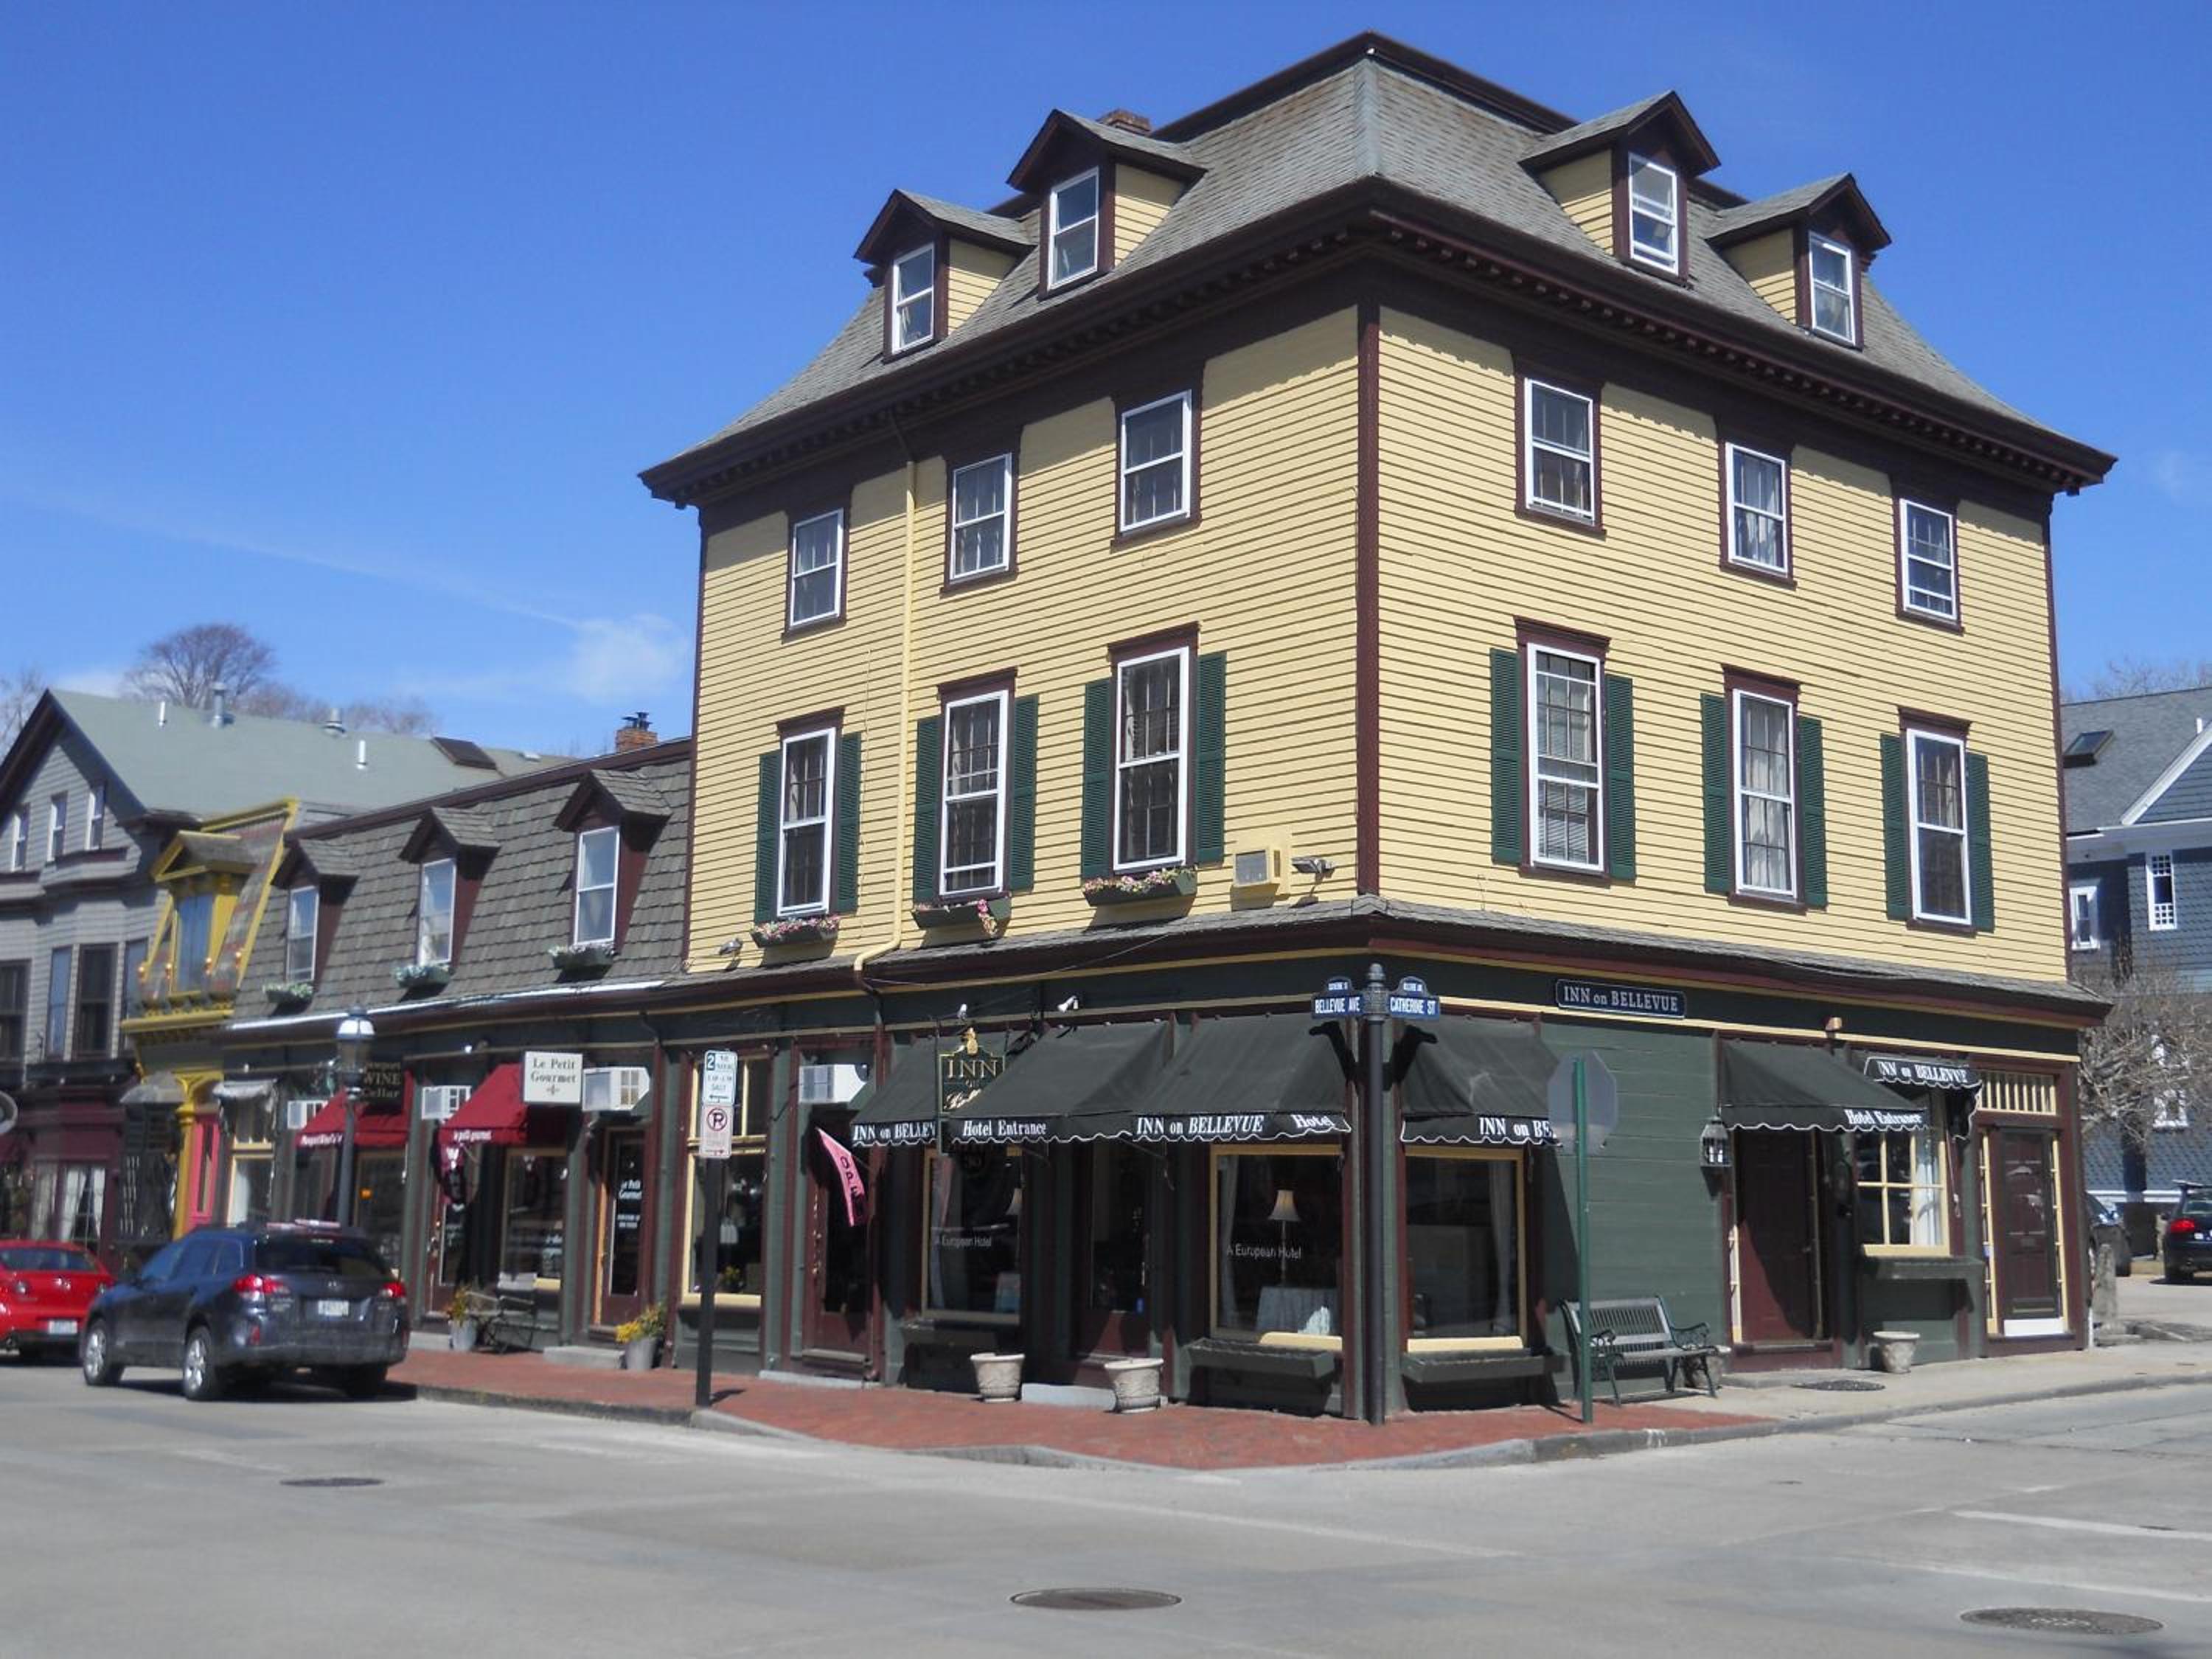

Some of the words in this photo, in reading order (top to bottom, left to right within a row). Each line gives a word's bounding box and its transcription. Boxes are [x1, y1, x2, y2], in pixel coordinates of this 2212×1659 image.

[1315, 998, 1346, 1014] BELLEVUE
[1348, 996, 1360, 1012] AVE
[1390, 997, 1425, 1015] CATHERINE
[1427, 1001, 1436, 1015] ST
[1563, 986, 1590, 1003] INN
[1593, 995, 1607, 1005] on
[1610, 990, 1678, 1012] BELLEVUE
[533, 1057, 544, 1068] Le
[551, 1058, 575, 1069] Petit
[707, 1054, 715, 1069] 2
[947, 1060, 998, 1079] INN
[530, 1070, 577, 1083] Gourmet
[1914, 1064, 1968, 1083] BELLEVUE
[1136, 1116, 1164, 1135] INN
[1169, 1121, 1183, 1134] on
[1188, 1114, 1265, 1134] BELLEVUE
[1292, 1113, 1335, 1129] Hotel
[1844, 1109, 1876, 1125] Hotel
[1874, 1110, 1922, 1125] Entrance
[853, 1124, 876, 1141] INN
[880, 1128, 891, 1139] on
[893, 1121, 936, 1139] BELLEV
[962, 1120, 992, 1136] Hotel
[998, 1119, 1047, 1136] Entrance
[1478, 1117, 1506, 1135] INN
[1513, 1124, 1530, 1136] on
[1226, 1244, 1234, 1256] A
[1235, 1243, 1276, 1260] European
[1277, 1245, 1302, 1259] Hotel
